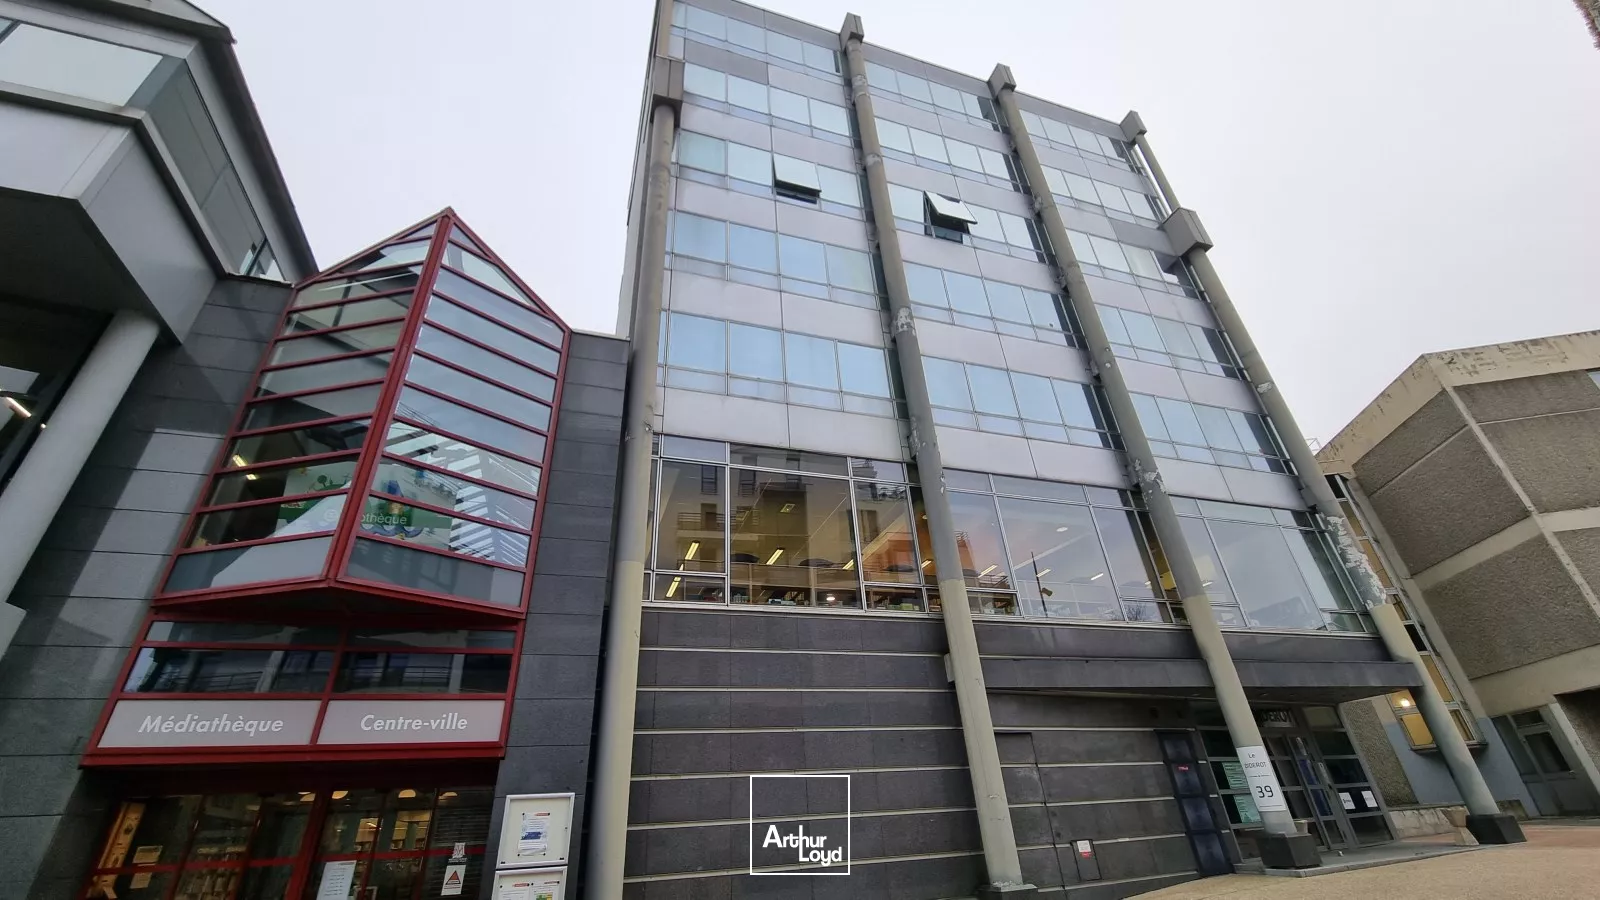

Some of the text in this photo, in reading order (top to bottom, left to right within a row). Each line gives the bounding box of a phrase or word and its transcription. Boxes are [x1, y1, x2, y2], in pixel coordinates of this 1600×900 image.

[360, 512, 407, 525] othèque
[138, 712, 468, 737] Médiathèque Centre-ville
[1247, 752, 1256, 760] Le
[1255, 785, 1274, 799] 39
